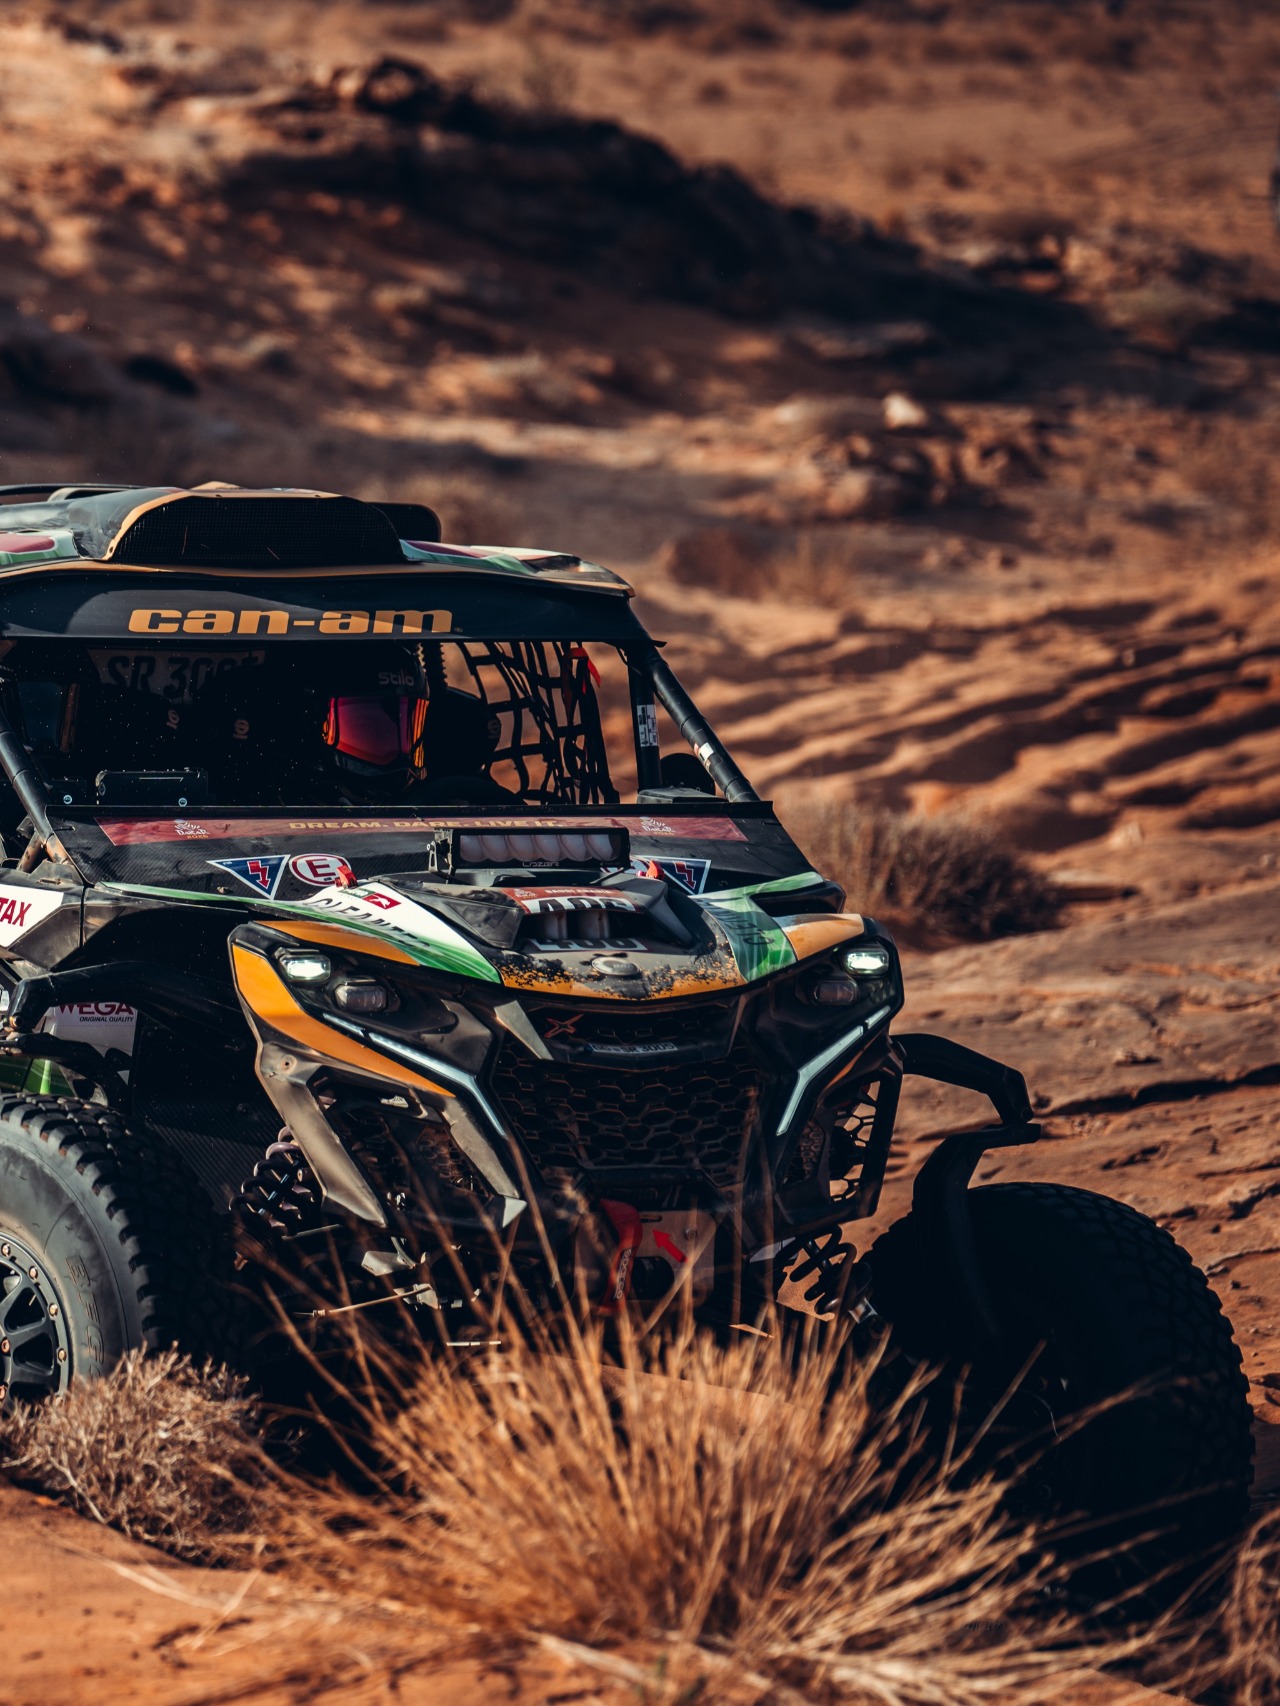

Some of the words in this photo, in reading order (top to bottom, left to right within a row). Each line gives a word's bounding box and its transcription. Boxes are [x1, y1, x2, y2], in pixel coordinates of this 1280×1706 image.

[128, 609, 453, 635] can-am
[378, 669, 415, 687] Stilo
[306, 858, 337, 878] E
